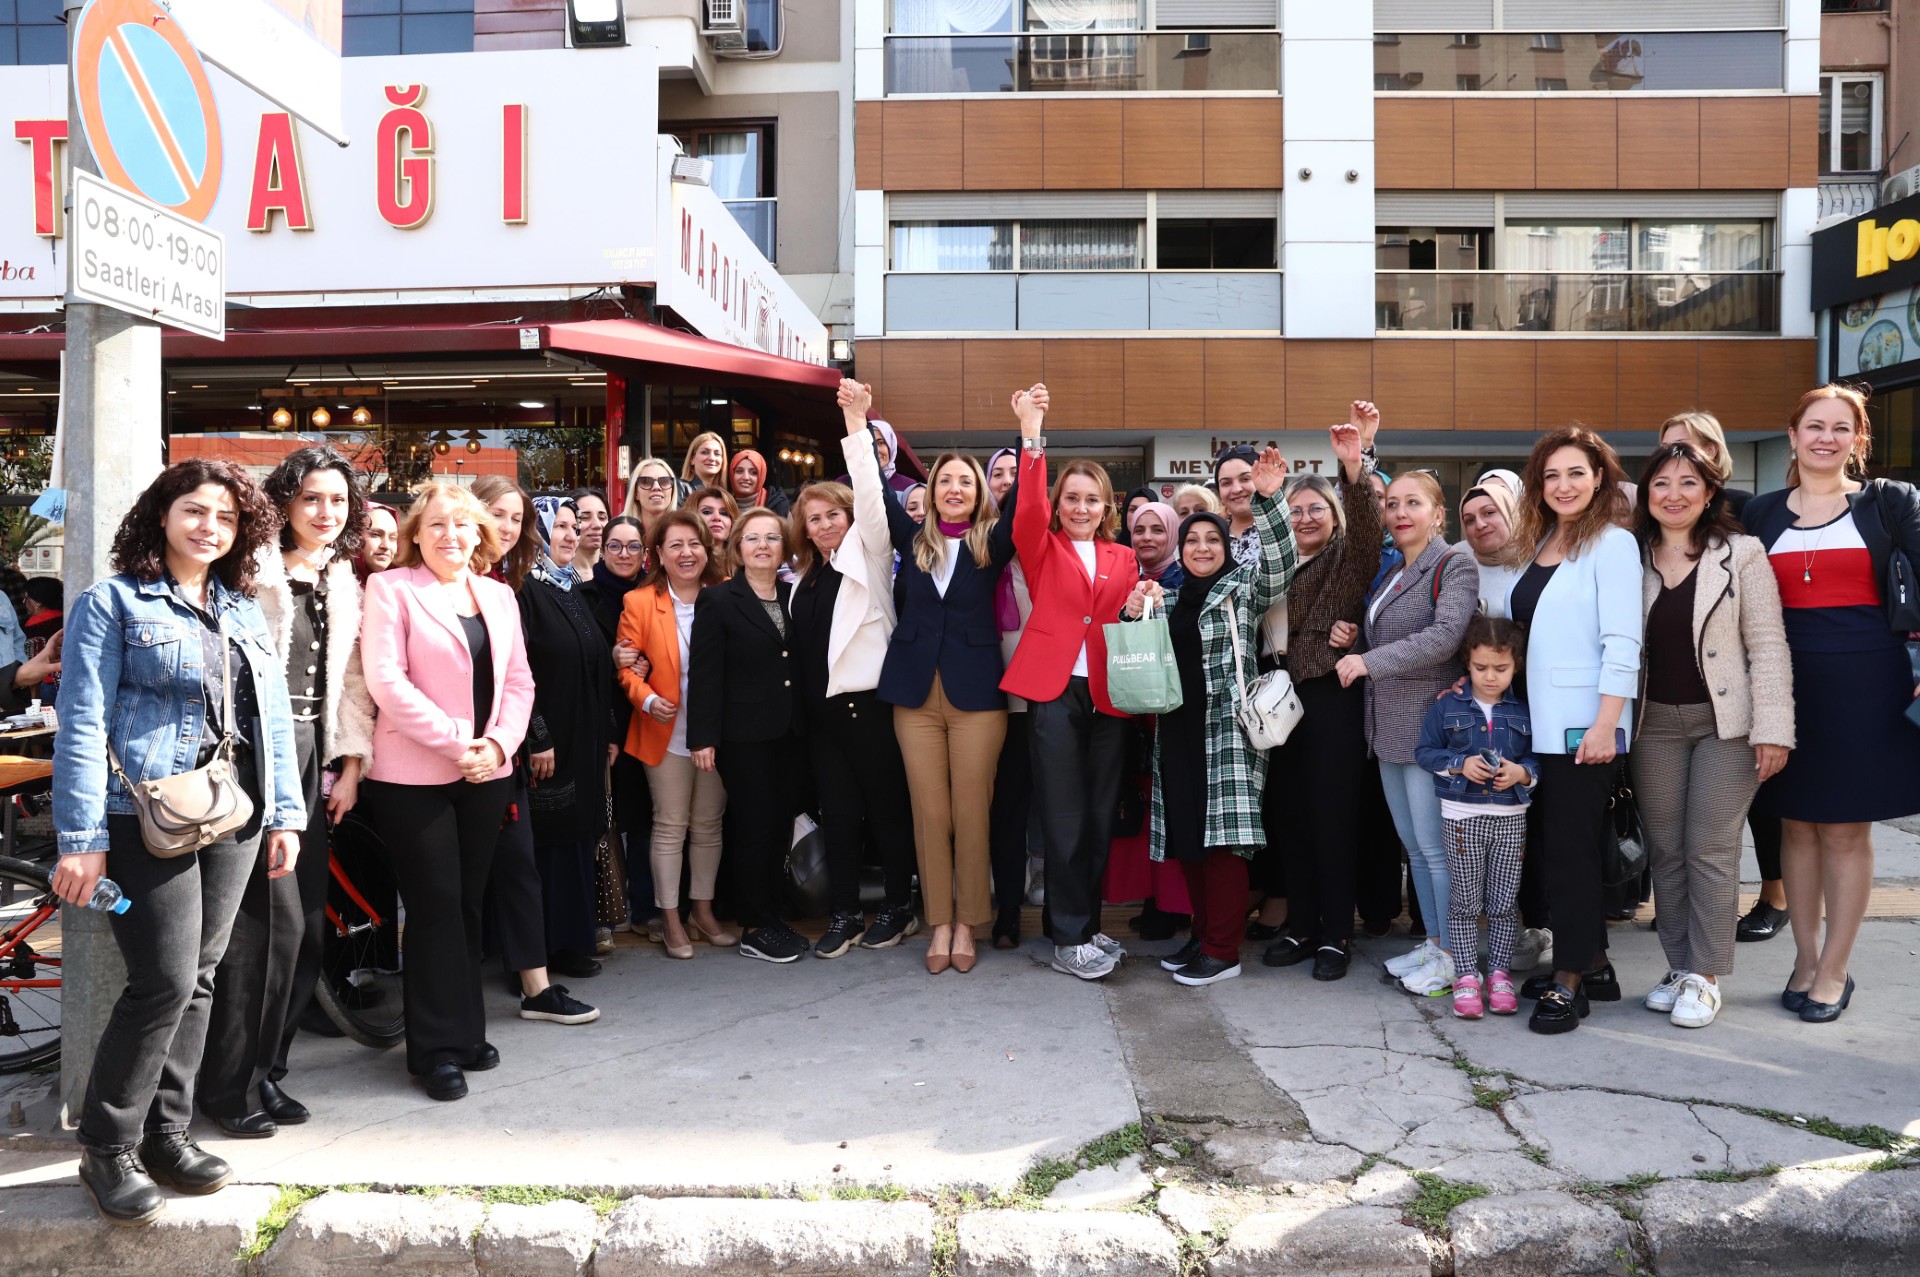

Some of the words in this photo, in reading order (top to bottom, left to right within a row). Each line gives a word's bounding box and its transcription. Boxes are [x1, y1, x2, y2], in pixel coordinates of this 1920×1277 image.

[14, 83, 528, 238] TAĞI
[0, 260, 35, 280] ba
[84, 197, 218, 276] 08:00-19:00
[681, 206, 748, 331] MARDİN
[84, 249, 166, 302] Saatleri
[171, 281, 218, 319] Arası
[1112, 652, 1156, 665] PULL&BEAR
